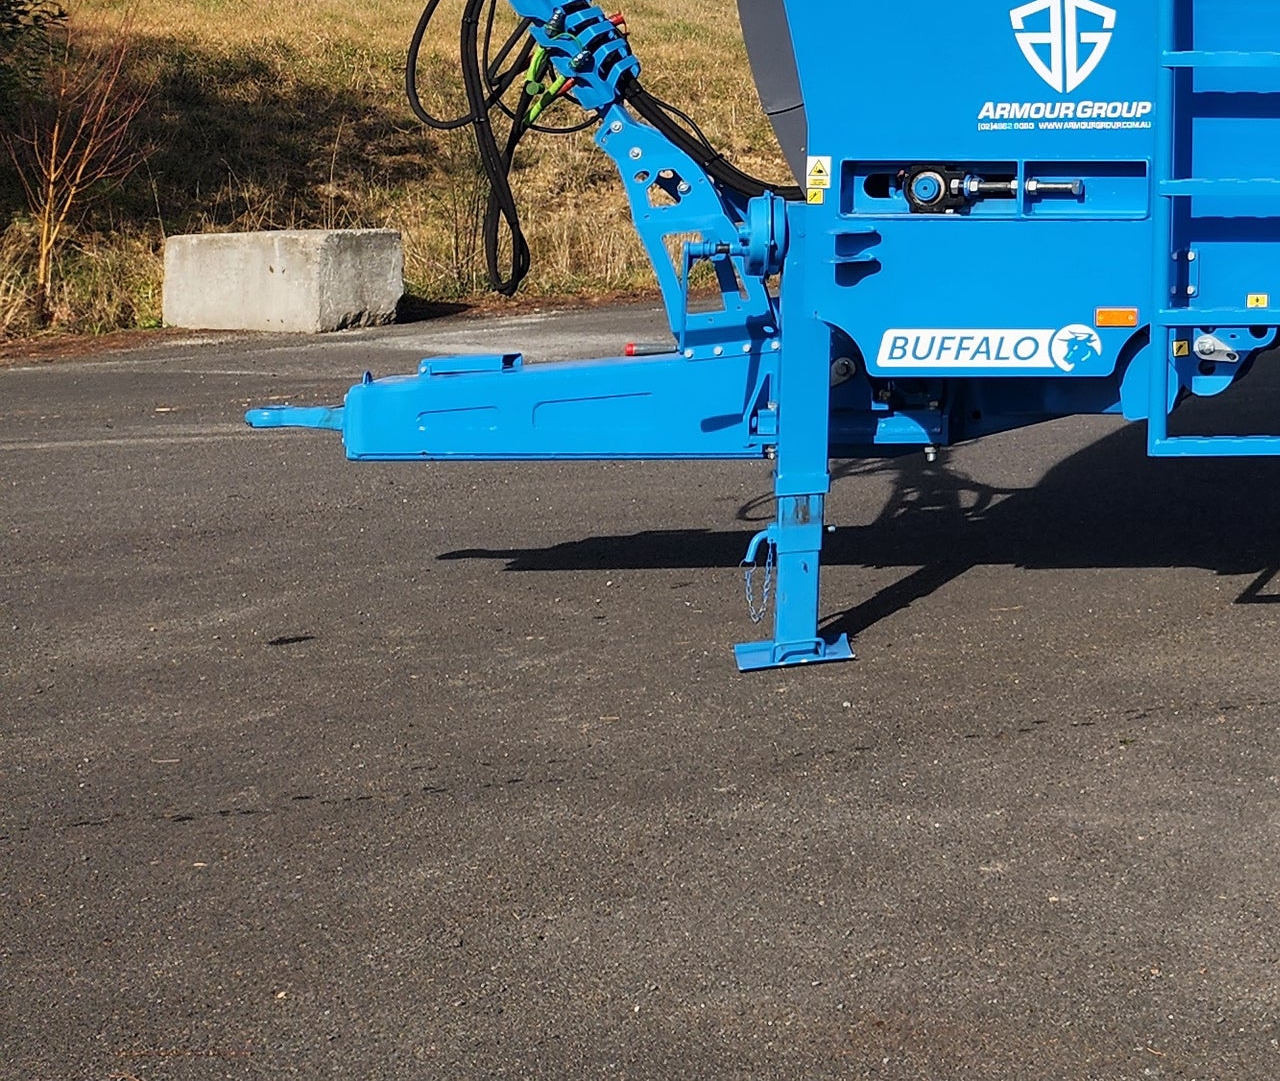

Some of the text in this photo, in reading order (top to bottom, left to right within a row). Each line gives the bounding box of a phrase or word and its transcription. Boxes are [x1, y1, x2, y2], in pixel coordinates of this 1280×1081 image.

[978, 100, 1152, 120] ARMOUR GROUP
[887, 335, 1040, 361] BUFFALO
